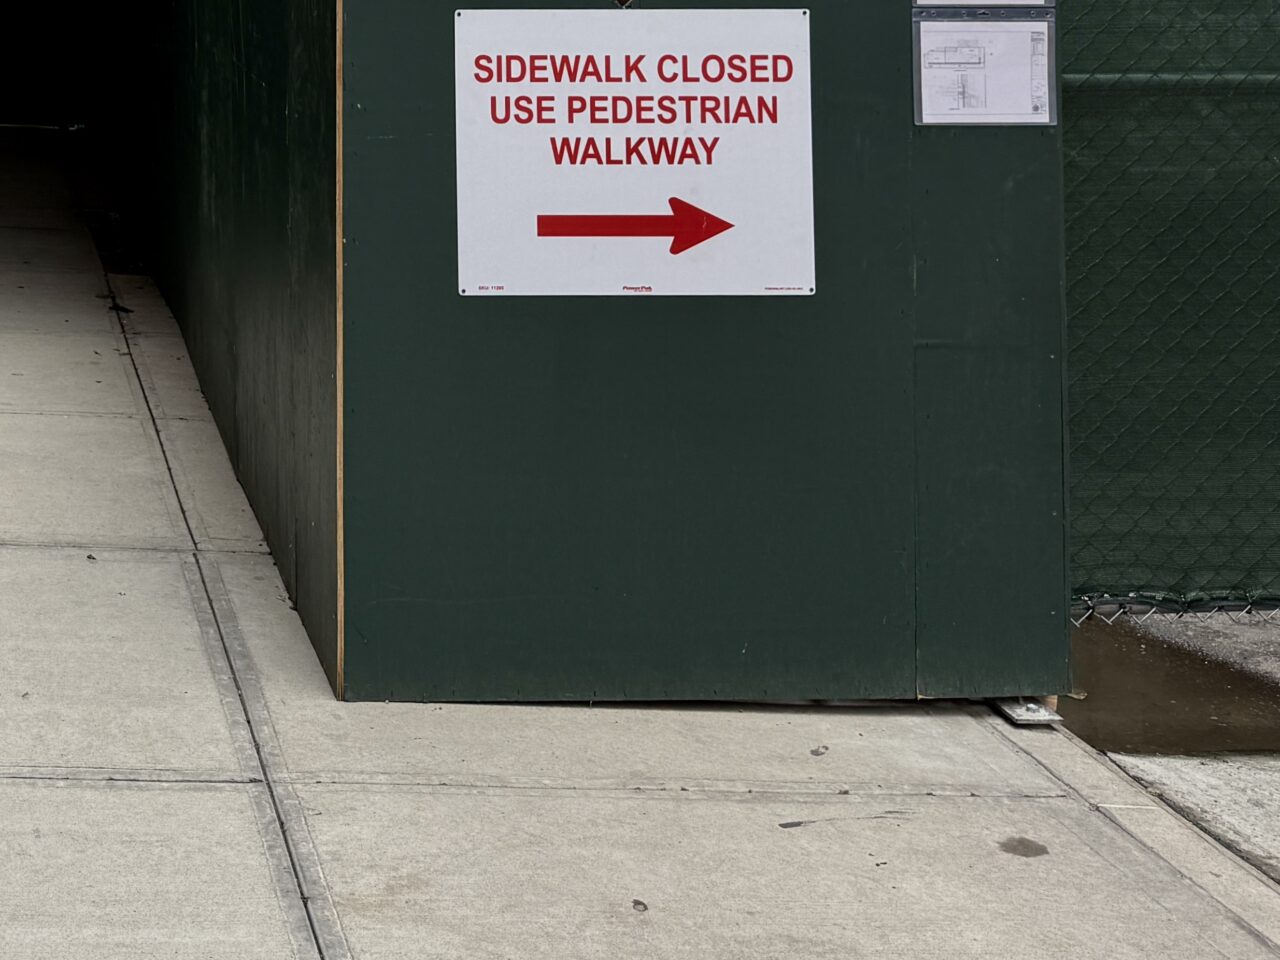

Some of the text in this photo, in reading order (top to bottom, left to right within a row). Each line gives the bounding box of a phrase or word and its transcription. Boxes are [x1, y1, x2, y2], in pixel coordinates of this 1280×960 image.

[474, 54, 793, 83] SIDEWALK CLOSED
[490, 95, 778, 124] USE PEDESTRIAN
[550, 136, 720, 165] WALKWAY
